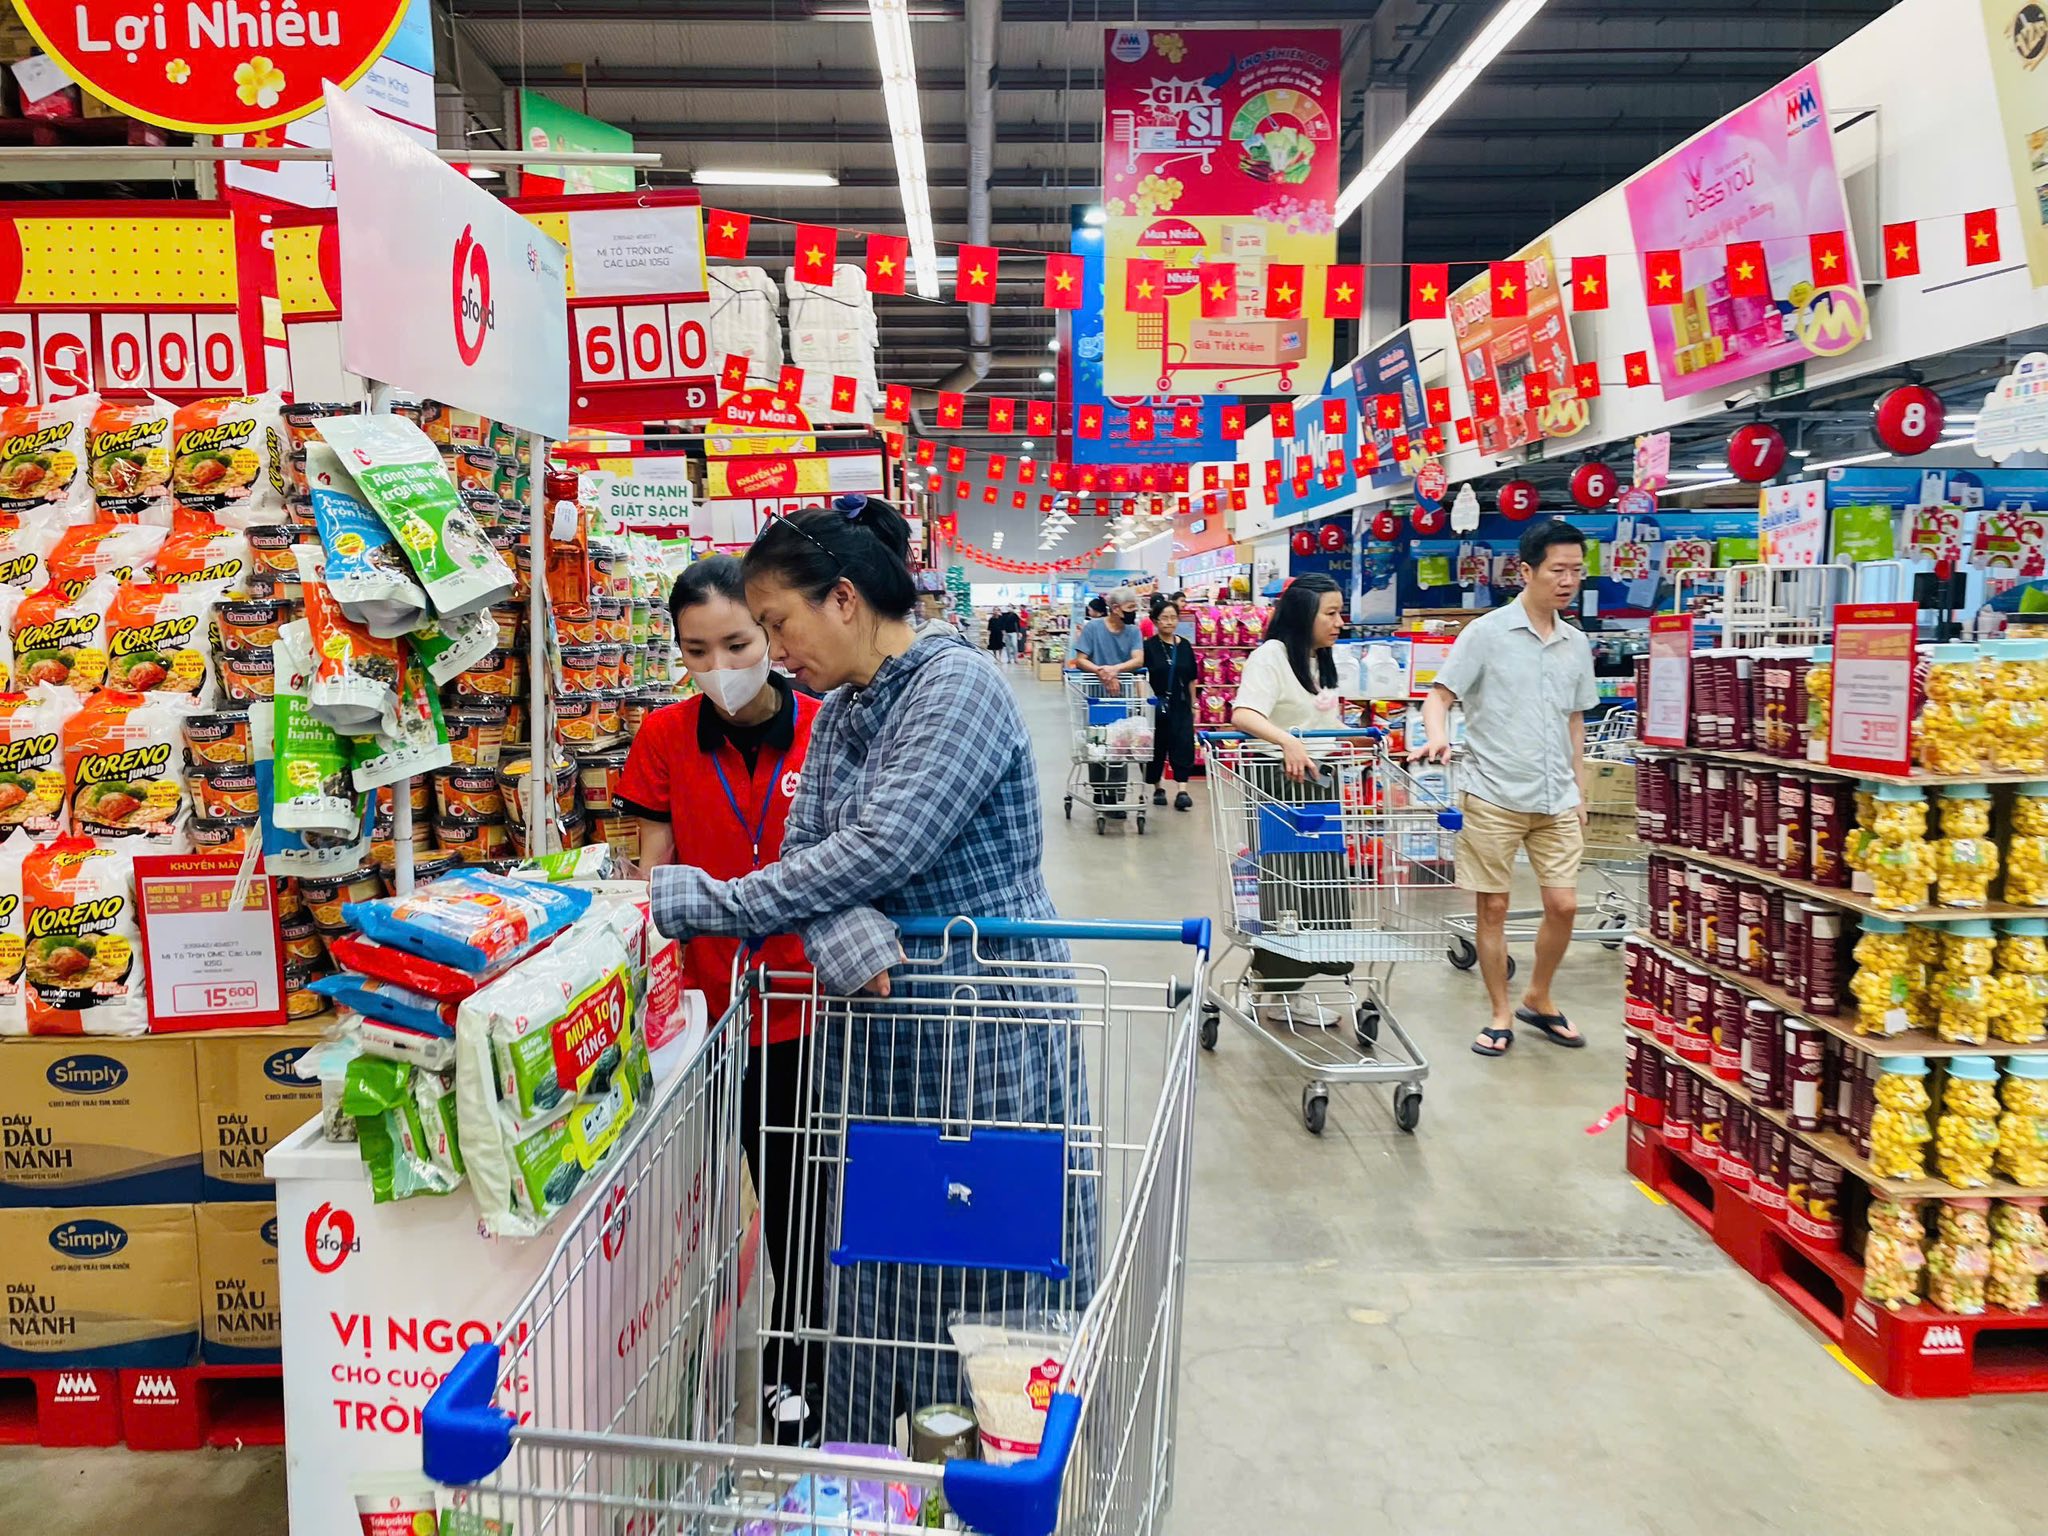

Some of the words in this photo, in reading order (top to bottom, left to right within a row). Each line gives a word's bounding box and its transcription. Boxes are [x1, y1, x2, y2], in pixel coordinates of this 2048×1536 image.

[76, 3, 167, 63] Lợi
[1152, 81, 1205, 104] GIÁ
[1188, 98, 1223, 137] SỈ
[1144, 229, 1167, 240] Mua
[1169, 226, 1199, 240] Nhiều
[1167, 270, 1200, 284] Nhiều
[1250, 289, 1260, 301] 2
[585, 319, 708, 376] 600
[727, 406, 756, 425] Buy
[759, 407, 797, 424] More
[1901, 402, 1926, 437] 8
[92, 418, 168, 458] KORENO
[175, 418, 257, 456] KORENO
[1751, 438, 1771, 467] 7
[611, 481, 641, 498] SỨC
[644, 484, 688, 501] MẠNH
[1587, 473, 1604, 497] 6
[1513, 489, 1529, 510] 5
[611, 502, 644, 521] GIẶT
[648, 505, 689, 521] SẠCH
[1420, 513, 1433, 527] 4
[1382, 517, 1394, 534] 3
[1301, 536, 1308, 550] 1
[1328, 531, 1340, 546] 2
[14, 613, 101, 655] KORENO
[108, 614, 199, 658] KORENO
[156, 632, 190, 652] JUMBO
[18, 753, 52, 773] JUMBO
[75, 743, 172, 785] KORENO
[128, 764, 166, 782] JUMBO
[169, 860, 216, 871] KHUYẾN
[218, 860, 240, 870] MÃI
[27, 895, 125, 939] KORENO
[78, 917, 117, 938] JUMBO
[609, 985, 621, 1034] 6
[565, 1014, 594, 1052] MUA
[593, 1001, 610, 1025] 10
[575, 1027, 608, 1068] TẶNG
[54, 1060, 122, 1085] Simply
[56, 1225, 122, 1250] Simply
[315, 1234, 361, 1253] ofood
[330, 1311, 371, 1358] VỊ
[388, 1315, 528, 1358] NGON
[331, 1363, 381, 1385] CHO
